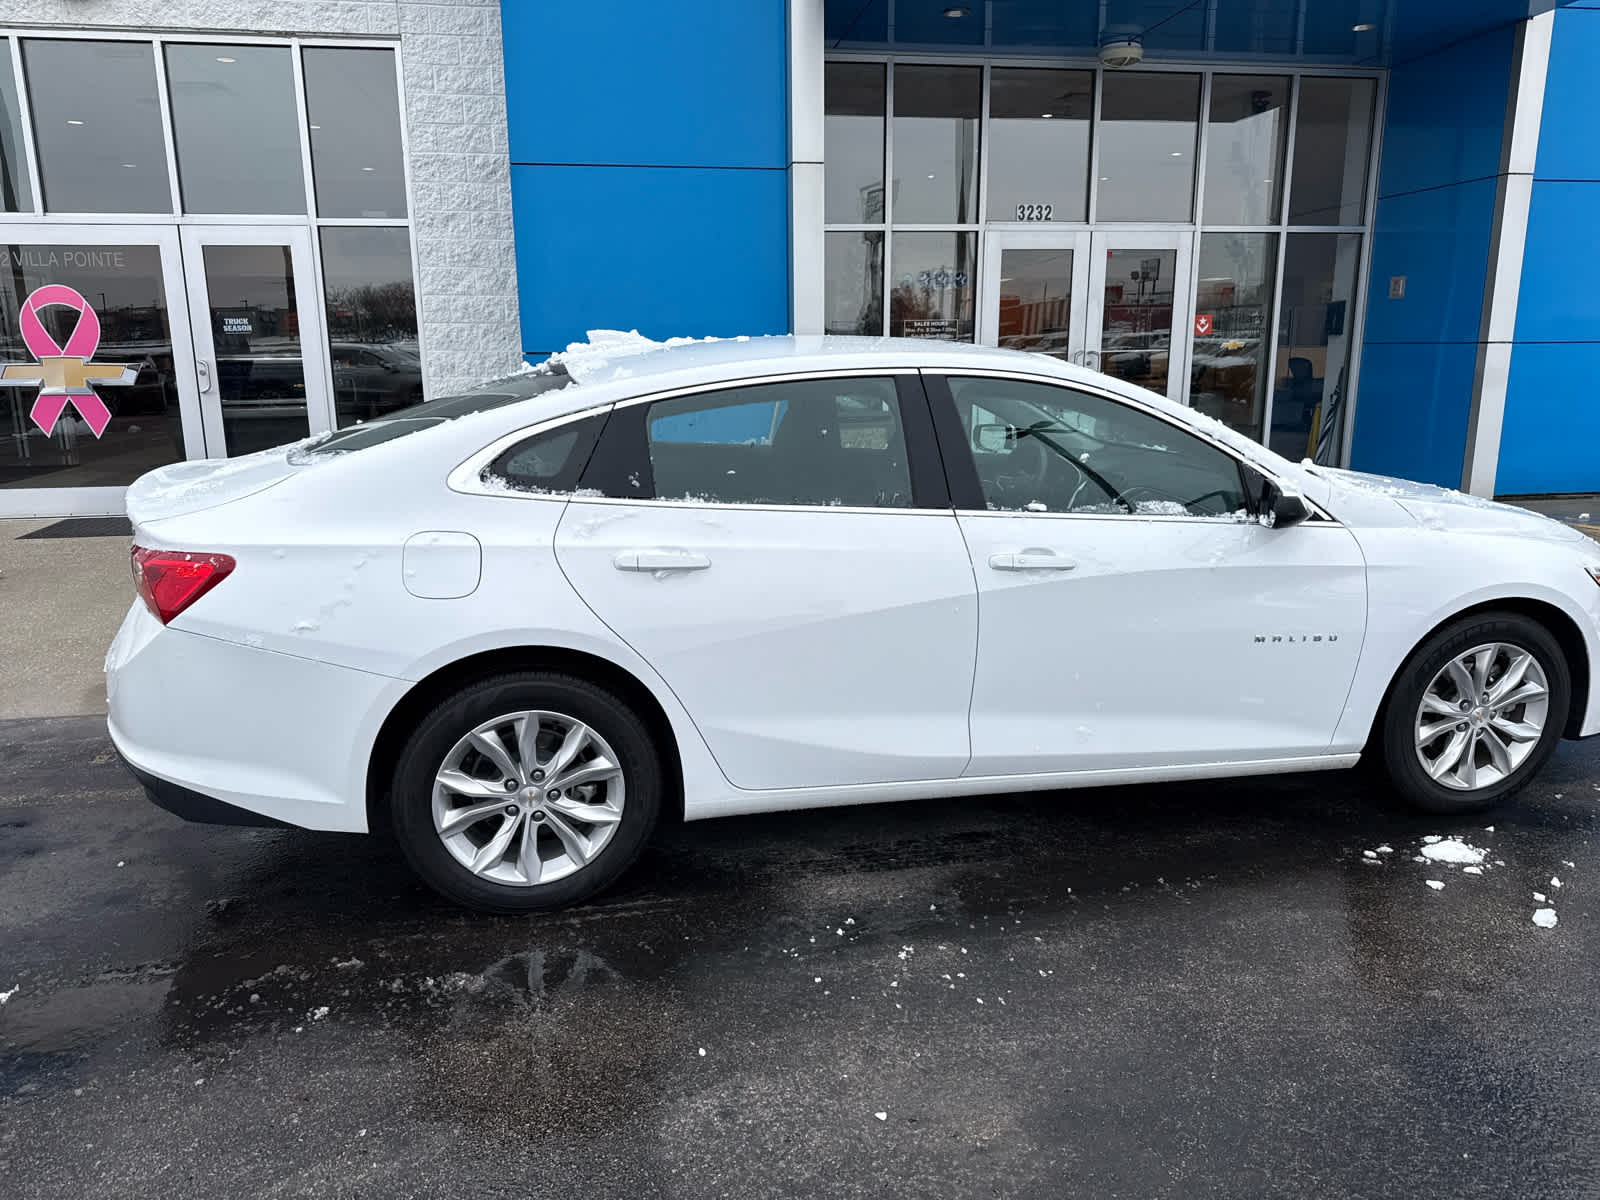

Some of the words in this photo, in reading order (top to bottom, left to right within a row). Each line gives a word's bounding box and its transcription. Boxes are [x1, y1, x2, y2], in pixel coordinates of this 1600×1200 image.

[1018, 204, 1052, 221] 3232
[12, 251, 59, 267] VILLA
[63, 251, 126, 268] POINTE
[223, 317, 249, 325] TRUCK
[223, 324, 253, 332] SEASON
[1254, 634, 1338, 643] MALIBU
